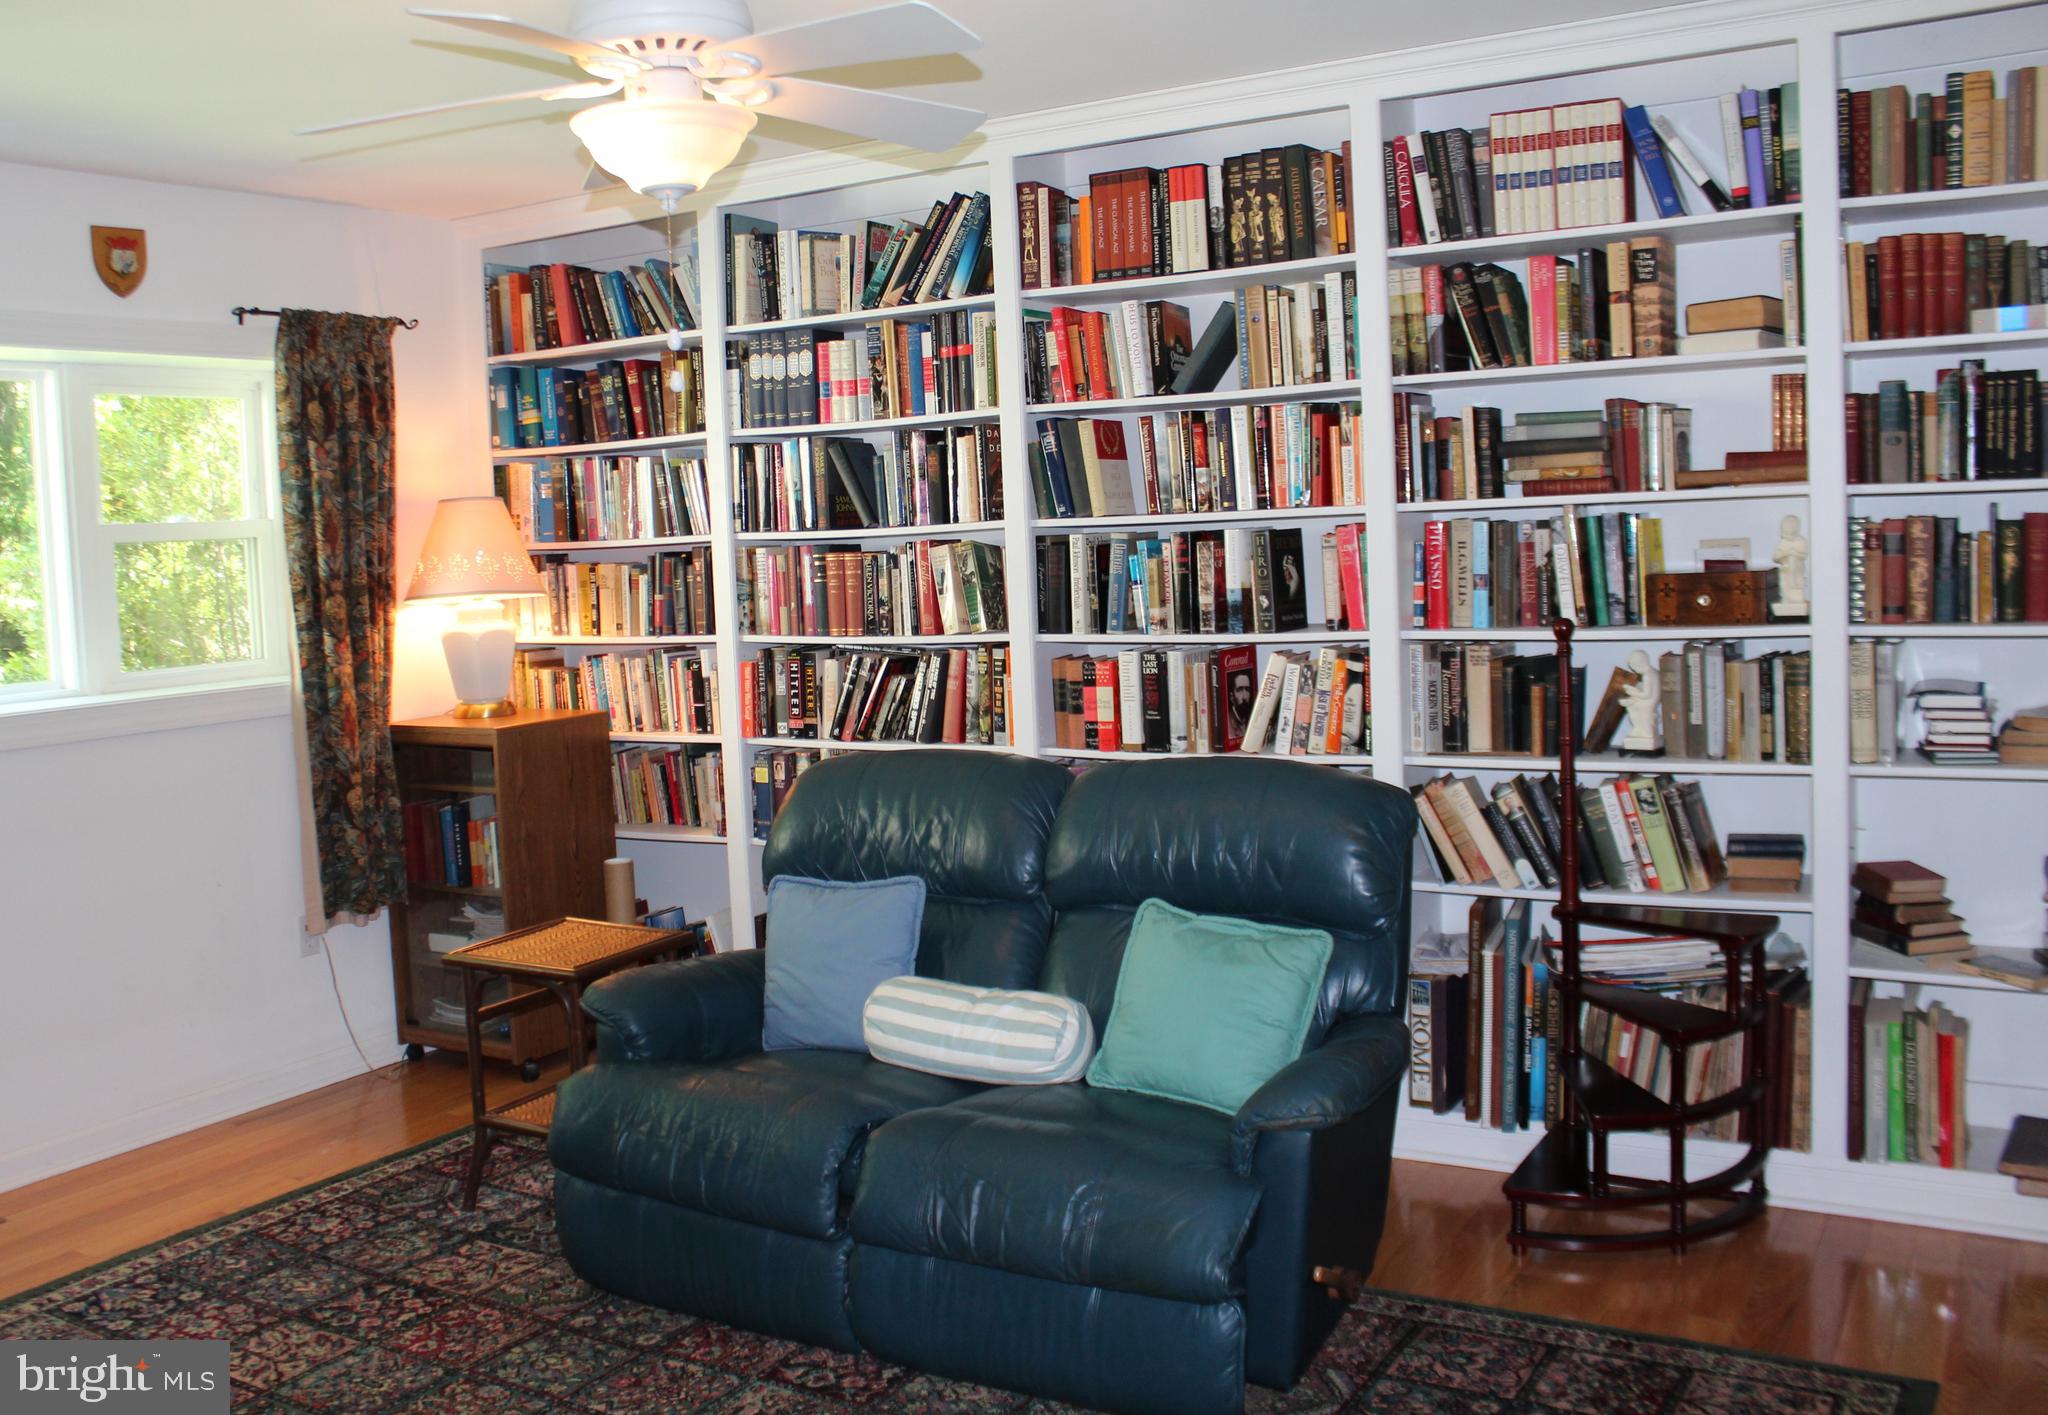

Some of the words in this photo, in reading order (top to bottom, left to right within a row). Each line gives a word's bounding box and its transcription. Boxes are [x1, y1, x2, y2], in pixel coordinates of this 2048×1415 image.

[1759, 103, 1770, 123] THE
[1838, 92, 1849, 147] KIPLING
[1762, 126, 1773, 166] DRUIDS
[1290, 166, 1302, 199] JULIUS
[1383, 146, 1395, 198] AUGUSTUS
[1395, 151, 1412, 209] CALIGULA
[1311, 167, 1328, 228] CAESAR
[1334, 168, 1343, 209] CICERO
[963, 193, 981, 221] ANCIENT
[1140, 204, 1148, 239] HELLENISTIC
[1293, 201, 1304, 239] CAESAR
[947, 226, 967, 258] MEDIEVAL
[934, 256, 952, 285] HISTORY
[532, 279, 543, 329] CHRISTIANITY
[1128, 303, 1138, 325] DEUS
[1086, 314, 1097, 349] MEDIEVAL
[1130, 328, 1139, 340] LO
[1271, 320, 1279, 347] Highland
[1038, 330, 1046, 367] SCOTLAND
[1131, 343, 1142, 370] VOLT!
[1153, 341, 1161, 366] Centuries
[1090, 349, 1100, 381] ENGLAND
[1141, 424, 1151, 451] Napoleon
[1182, 429, 1190, 460] WATERLOO
[1144, 451, 1154, 482] Bonaparte
[1071, 537, 1081, 550] Paul
[1113, 543, 1127, 575] DREYFUS
[1255, 536, 1267, 577] HERO
[1429, 525, 1442, 590] PICASSO
[1071, 550, 1081, 574] Johnson
[1526, 552, 1537, 603] EINSTEIN
[1555, 547, 1569, 593] ORWELL
[866, 583, 875, 621] VICTORIA
[1073, 576, 1084, 610] Intellectuals
[757, 662, 765, 693] HITLER
[1210, 665, 1219, 688] Conrad
[1223, 655, 1249, 668] Conrad
[1336, 672, 1345, 683] The
[789, 663, 799, 716] HITLER
[806, 669, 815, 709] HITLER
[1121, 653, 1136, 703] Churchill
[1265, 673, 1280, 698] Evelyn
[1281, 667, 1298, 704] WODEHOUSE
[1333, 682, 1343, 701] Philby
[1316, 689, 1331, 704] MASK
[1427, 680, 1439, 710] MODERN
[1441, 669, 1452, 727] Remembers
[907, 710, 918, 736] SPIES
[1313, 710, 1329, 737] TREACHERY
[1329, 701, 1341, 736] Conspiracy
[1428, 711, 1440, 732] TIMES
[1507, 929, 1518, 970] NATIONAL
[1506, 972, 1518, 1025] GEOGRAPHIC
[1506, 1027, 1517, 1051] ATLAS
[1525, 1018, 1534, 1040] ATLAS
[1412, 1012, 1431, 1085] ROME
[1506, 1052, 1517, 1064] OF
[1524, 1053, 1533, 1073] BIBLE
[1505, 1066, 1516, 1081] THE
[1904, 1040, 1917, 1106] LOHENGRIN
[1505, 1083, 1516, 1113] WORLD
